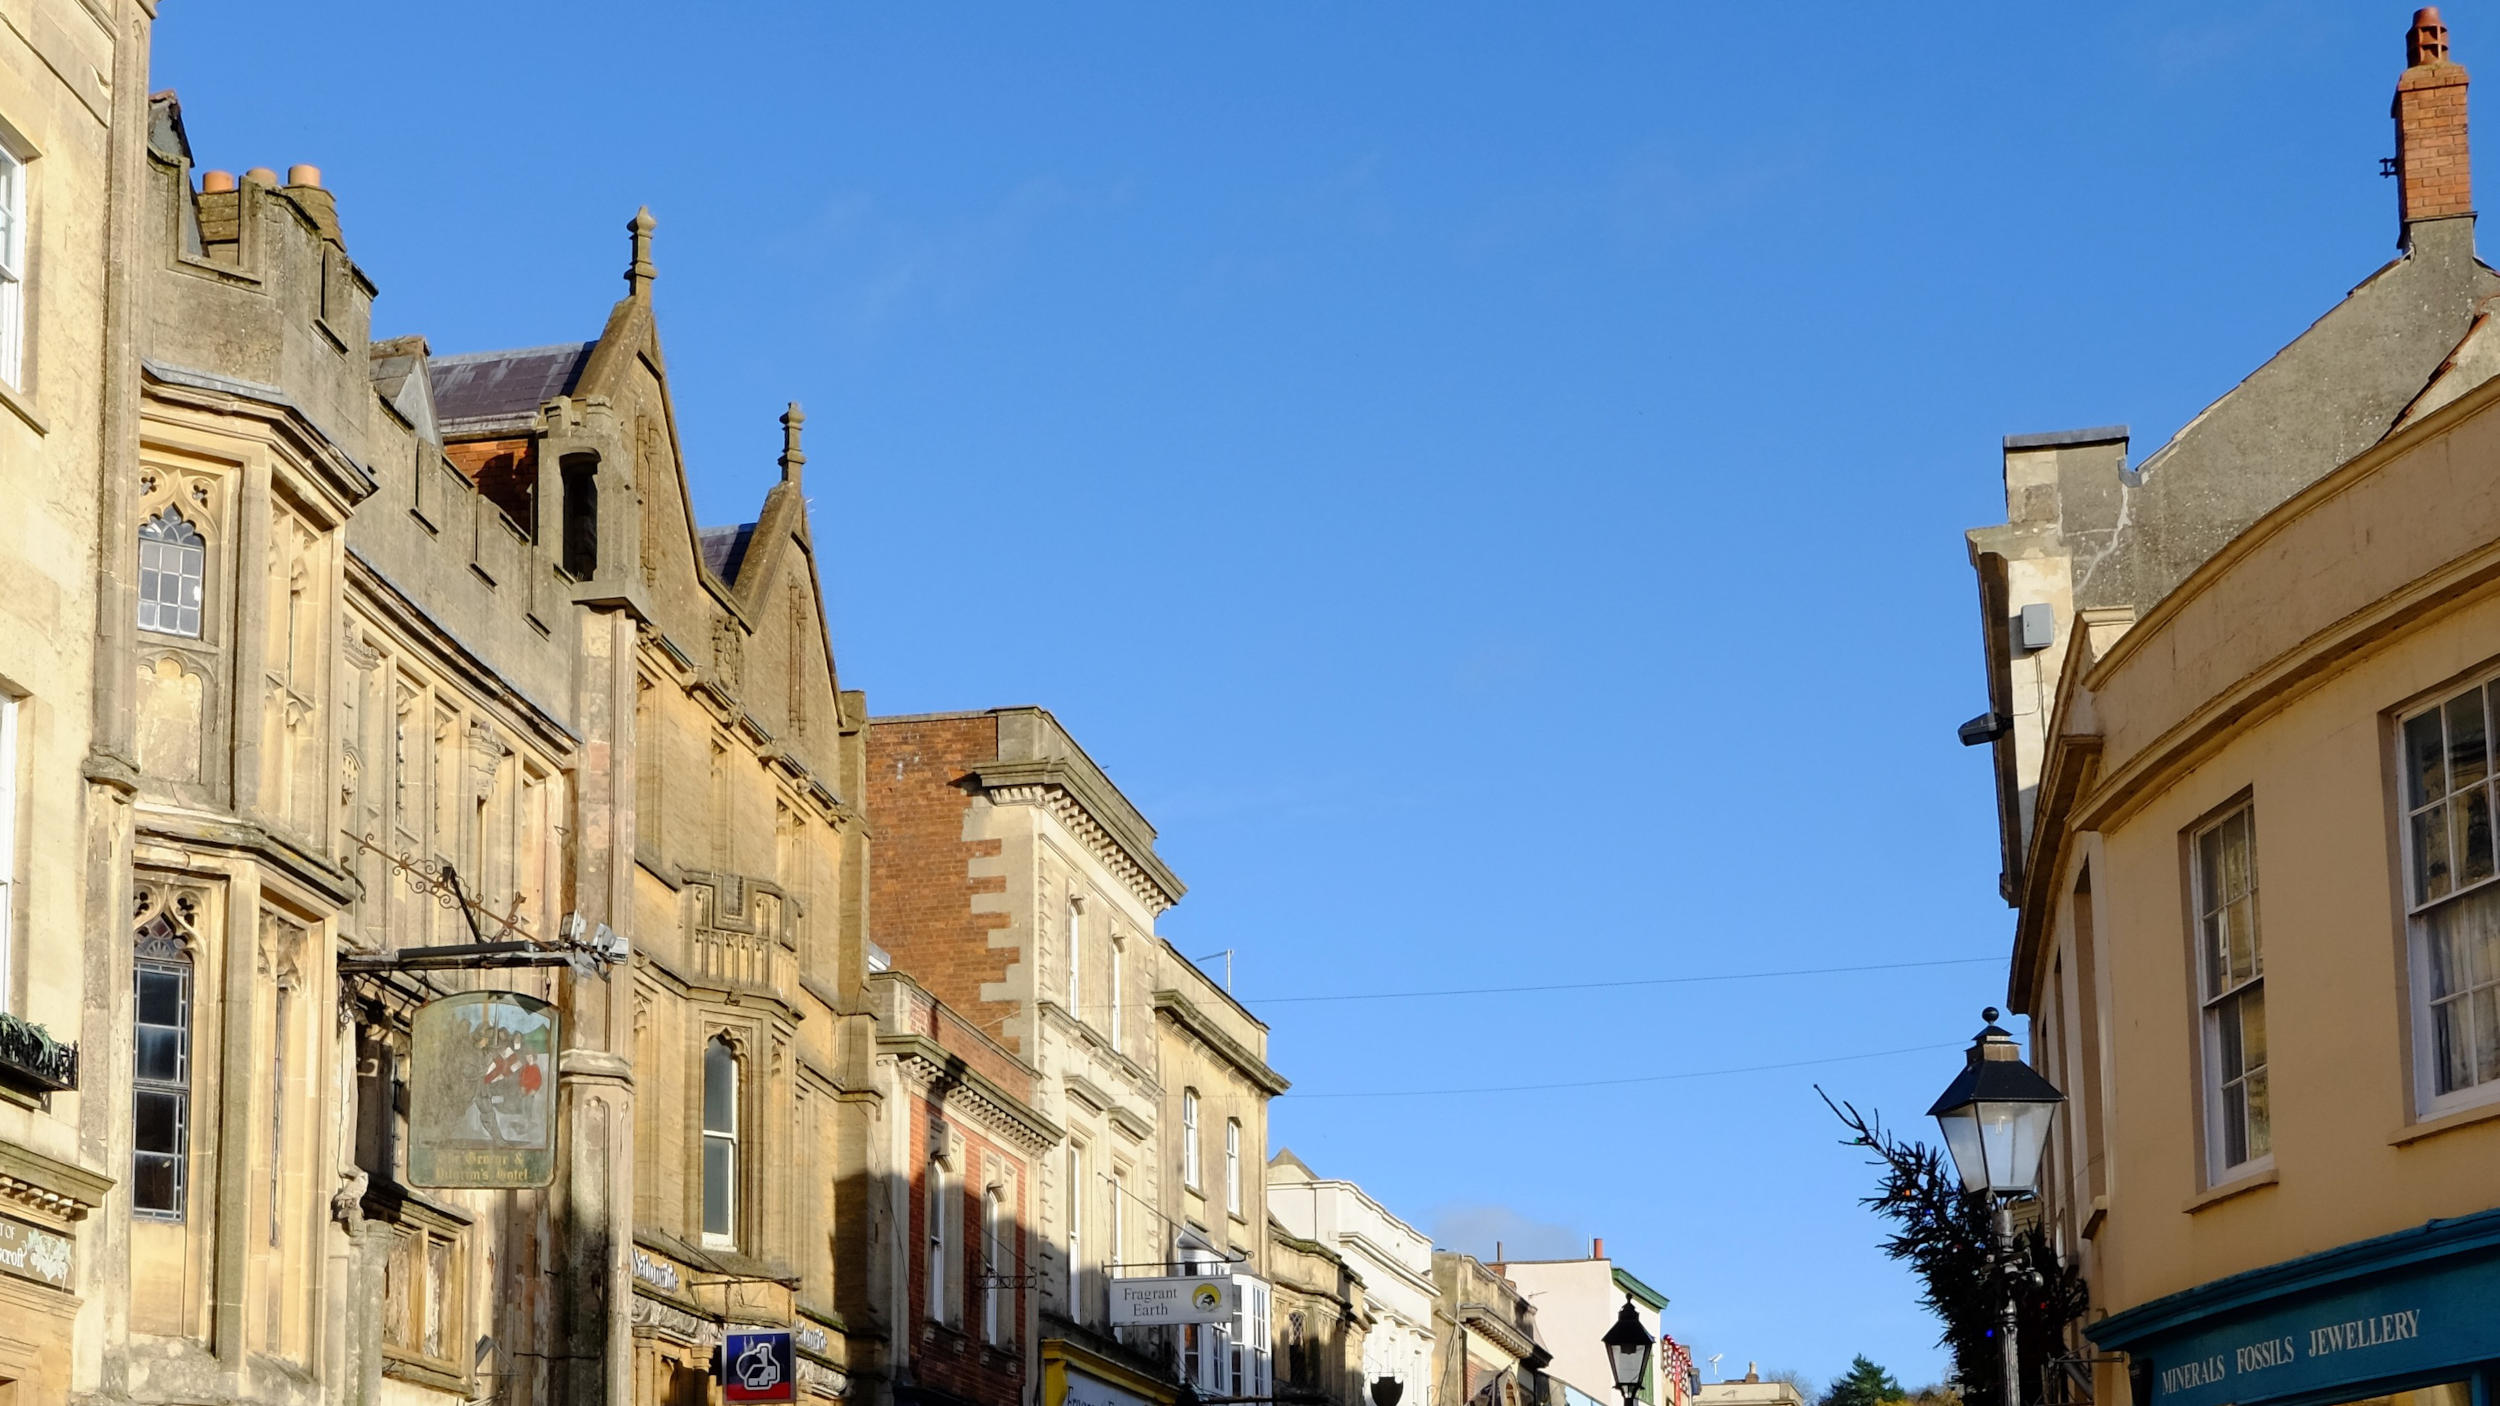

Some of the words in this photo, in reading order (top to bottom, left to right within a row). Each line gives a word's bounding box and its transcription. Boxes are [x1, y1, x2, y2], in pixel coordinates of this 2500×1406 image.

[1124, 1288, 1177, 1303] Fragrant
[1133, 1303, 1168, 1317] Earth
[2162, 1354, 2225, 1395] MINERALS
[2236, 1336, 2295, 1375] FOSSILS
[2308, 1309, 2421, 1358] JEWELLERY
